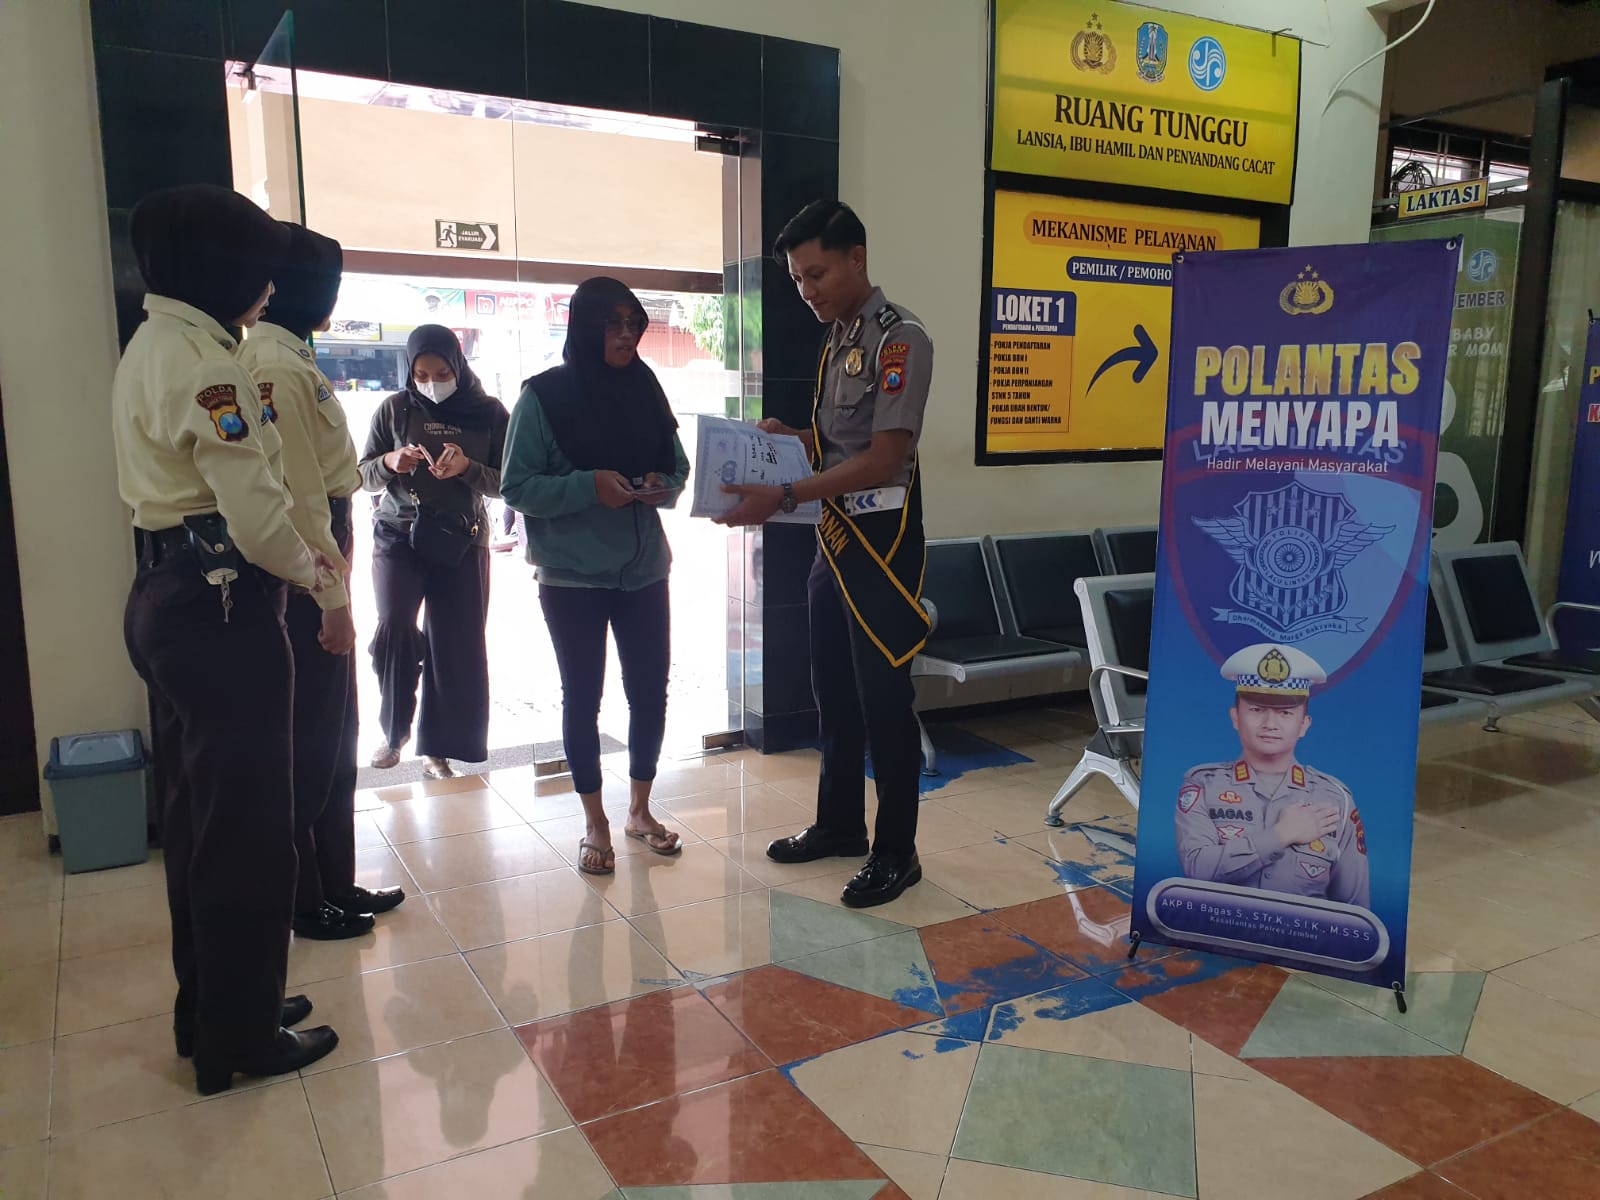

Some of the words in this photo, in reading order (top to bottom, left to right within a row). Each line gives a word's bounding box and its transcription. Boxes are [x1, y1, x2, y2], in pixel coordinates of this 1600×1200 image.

[1054, 94, 1143, 134] RUANG
[1150, 108, 1249, 147] TUNGGU
[1017, 129, 1067, 153] LANSIA,
[1069, 135, 1092, 153] IBU
[1095, 139, 1136, 158] HAMIL
[1138, 145, 1164, 162] DAN
[1166, 150, 1240, 171] PENYANDANG
[1241, 158, 1275, 175] CACAT
[1406, 184, 1481, 212] LAKTASI
[1032, 219, 1127, 244] MEKANISME
[1134, 228, 1216, 251] PELAYANAN
[1072, 261, 1118, 277] PEMILIK
[1127, 266, 1173, 281] PEMOHO
[996, 294, 1053, 322] LOKET
[1056, 297, 1065, 323] 1
[1452, 327, 1495, 341] BABY
[994, 341, 1013, 349] POKJA
[1465, 342, 1503, 358] MOM
[993, 354, 1011, 362] POKJA
[993, 366, 1011, 375] POKJA
[1193, 341, 1422, 396] POLANTAS
[992, 379, 1011, 387] POKJA
[196, 385, 234, 402] POLDA
[1012, 392, 1031, 400] TAHUN
[991, 404, 1010, 412] POKJA
[990, 417, 1011, 425] FUNGSI
[1041, 416, 1062, 424] WARNA
[1200, 400, 1399, 448] MENYAPA
[1207, 457, 1242, 470] Hadir
[1245, 458, 1304, 474] Melayani
[1308, 458, 1388, 475] Masyarakat
[1208, 808, 1254, 823] BAGAS
[1161, 899, 1183, 909] AKP
[1200, 903, 1232, 916] Bagas
[1209, 915, 1257, 929] Kasatlantas
